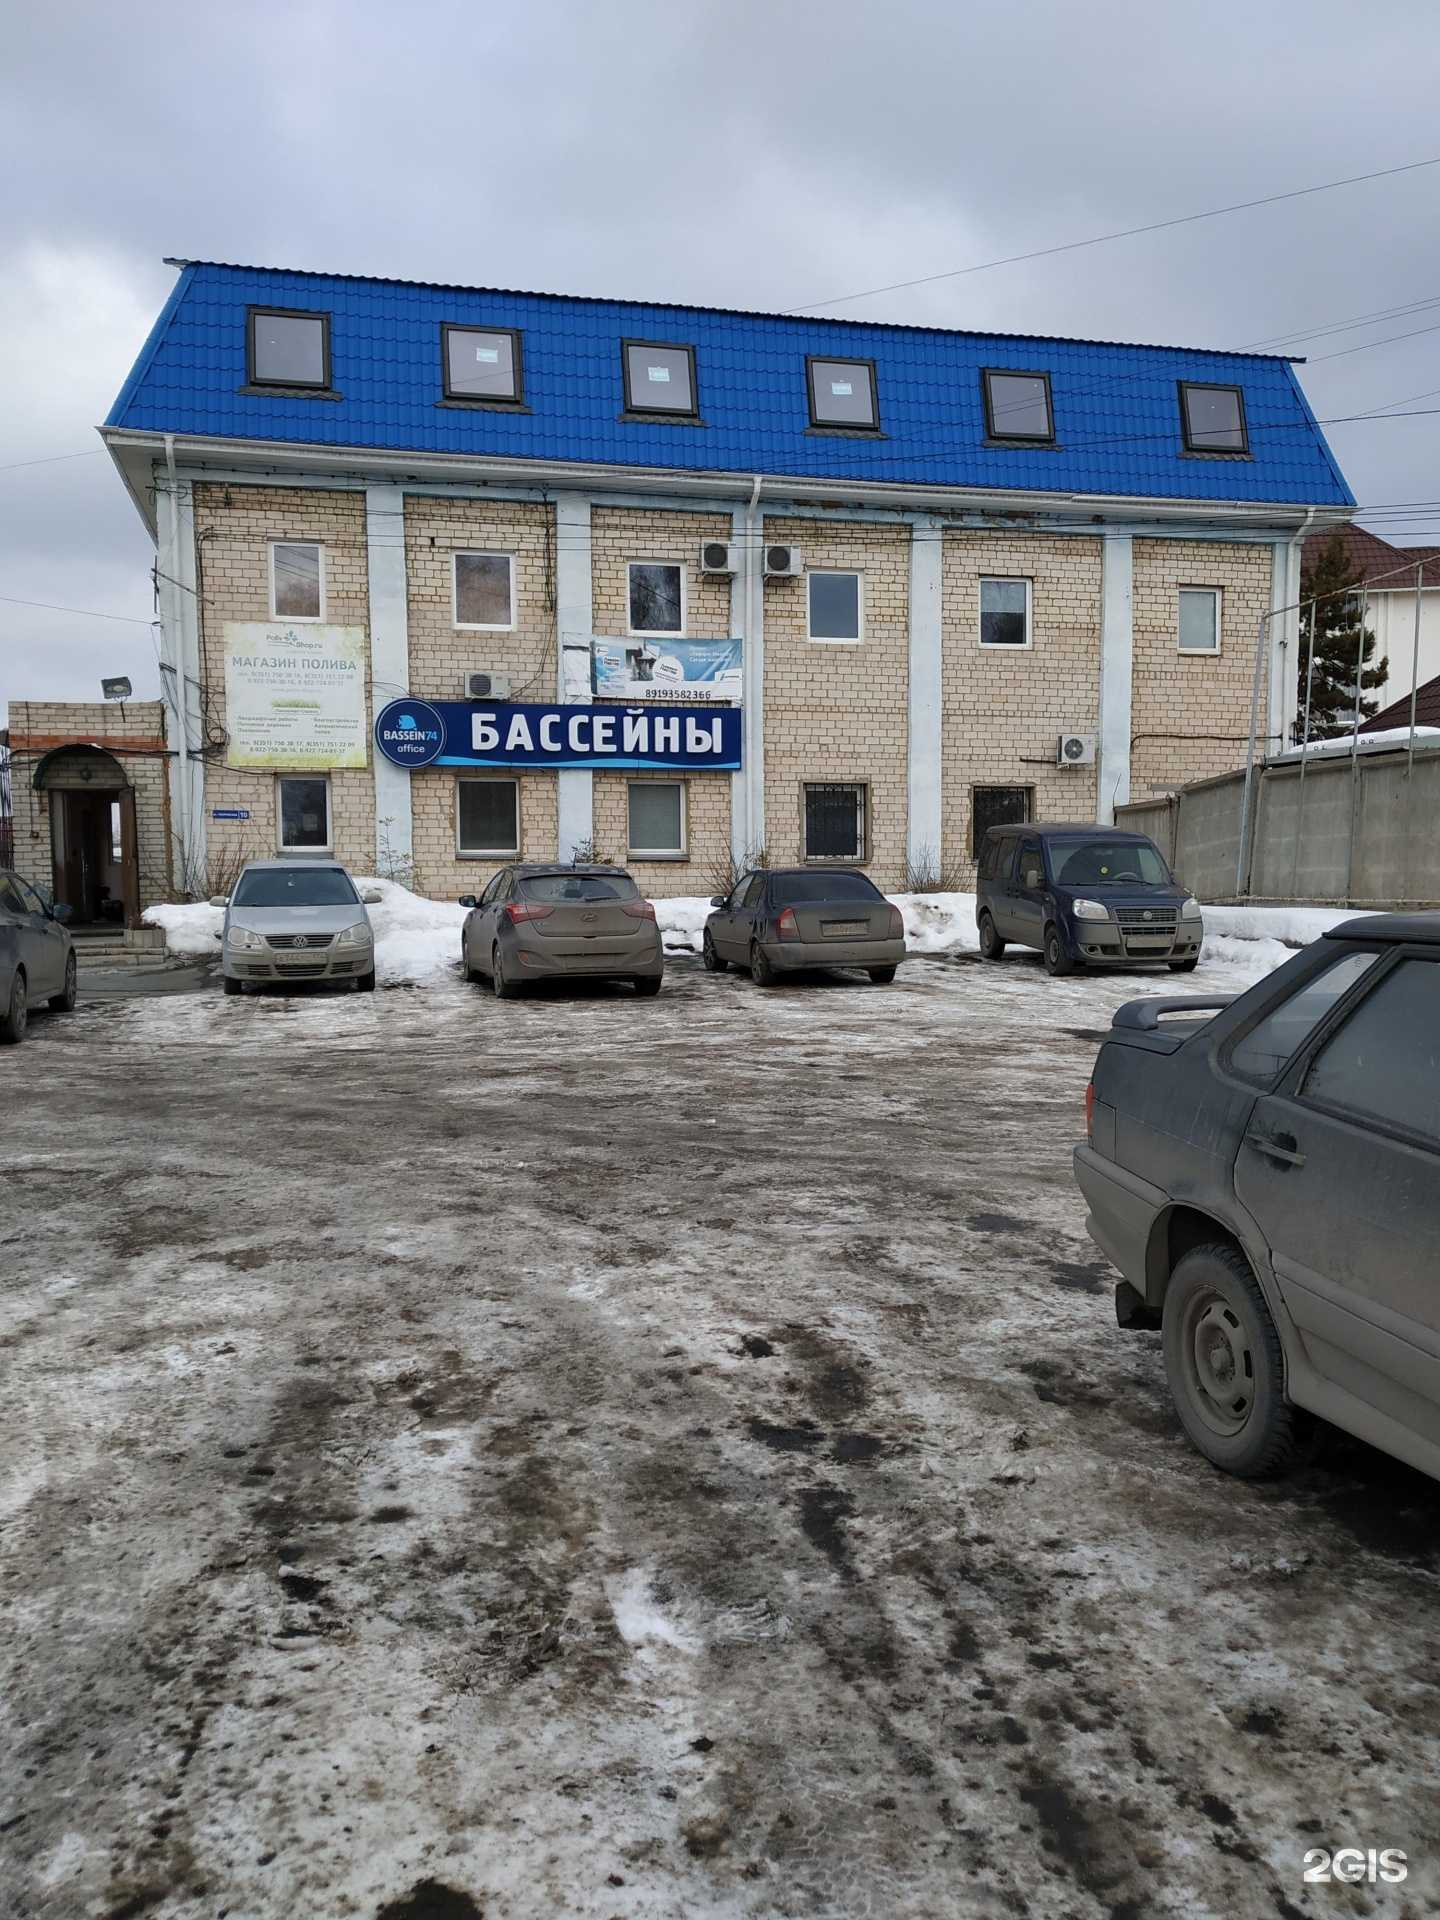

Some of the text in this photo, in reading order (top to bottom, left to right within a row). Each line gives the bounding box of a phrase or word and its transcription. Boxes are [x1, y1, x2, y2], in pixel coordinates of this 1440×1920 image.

[232, 656, 357, 670] МАГАЗИН ПОЛИВА
[645, 689, 711, 700] 89193582366
[471, 708, 723, 755] БАССЕЙНЫ
[397, 744, 425, 753] office
